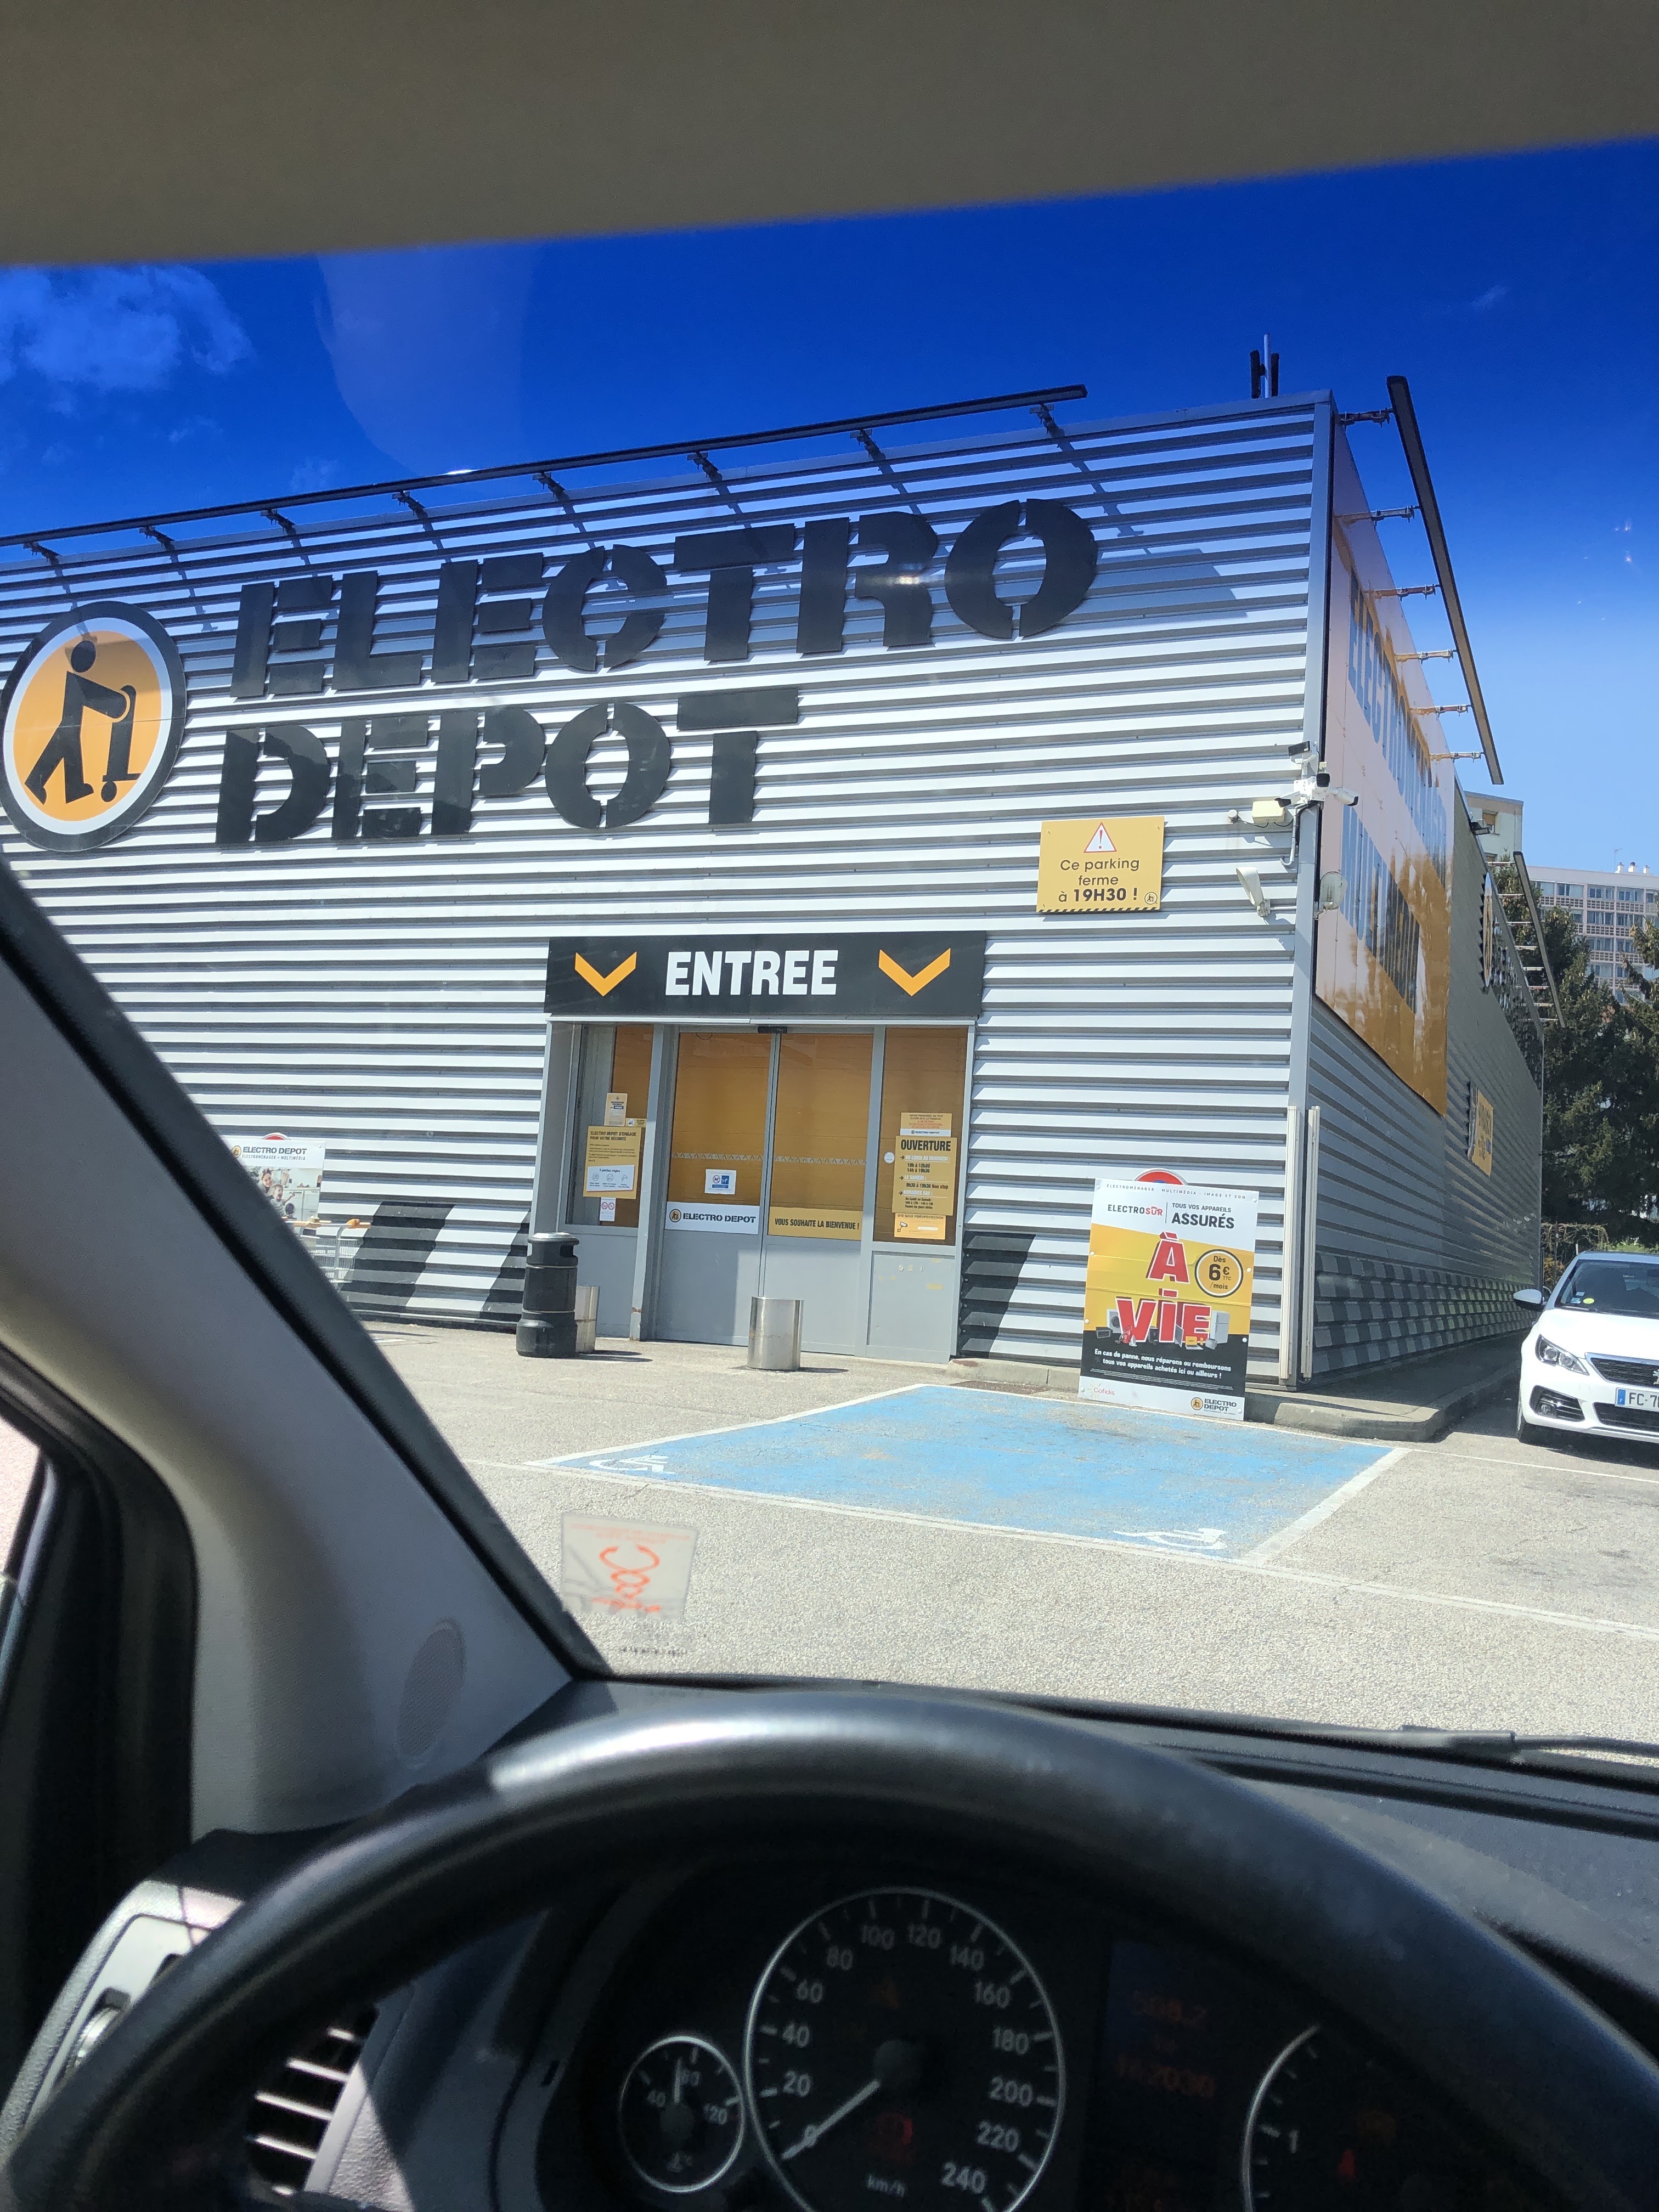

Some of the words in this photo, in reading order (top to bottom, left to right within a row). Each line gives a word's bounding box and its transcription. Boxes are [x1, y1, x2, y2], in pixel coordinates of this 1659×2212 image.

[230, 498, 1097, 698] ELECTRO
[216, 687, 799, 843] DEPOT
[1060, 859, 1079, 871] Ce
[1085, 858, 1139, 872] parking
[1079, 875, 1119, 885] ferme
[1059, 891, 1067, 902] à
[1074, 888, 1126, 902] 19H30
[1133, 887, 1137, 900] !
[665, 950, 838, 996] ENTREE
[901, 1139, 951, 1151] OUVERTURE
[683, 1213, 723, 1222] ELECTRO
[724, 1215, 756, 1223] DEPOT
[790, 1219, 816, 1227] SOUHAITE
[826, 1221, 855, 1229] BIENVENUE
[1171, 1212, 1234, 1229] ASSURÉS
[1146, 1231, 1190, 1284] À
[1127, 1362, 1153, 1370] appareils
[1154, 1364, 1177, 1373] achetés
[1195, 1370, 1217, 1379] ailleurs
[1156, 1357, 1182, 1366] réparons
[1192, 1361, 1231, 1372] remboursons
[1093, 1387, 1115, 1396] Cofidis
[1204, 1398, 1237, 1407] ELECTRO
[861, 1923, 894, 1951] 100
[907, 1924, 942, 1949] 120
[827, 1947, 854, 1971] 80
[949, 1944, 986, 1971] 140
[795, 1980, 824, 2004] 60
[974, 1982, 1011, 2008] 160
[782, 2024, 811, 2049] 40
[992, 2028, 1030, 2054] 180
[784, 2070, 812, 2097] 20
[990, 2077, 1033, 2107] 200
[647, 2089, 666, 2108] 40
[703, 2103, 728, 2125] 120
[977, 2120, 1019, 2152] 220
[865, 2174, 907, 2198] km/h
[941, 2162, 986, 2193] 240
